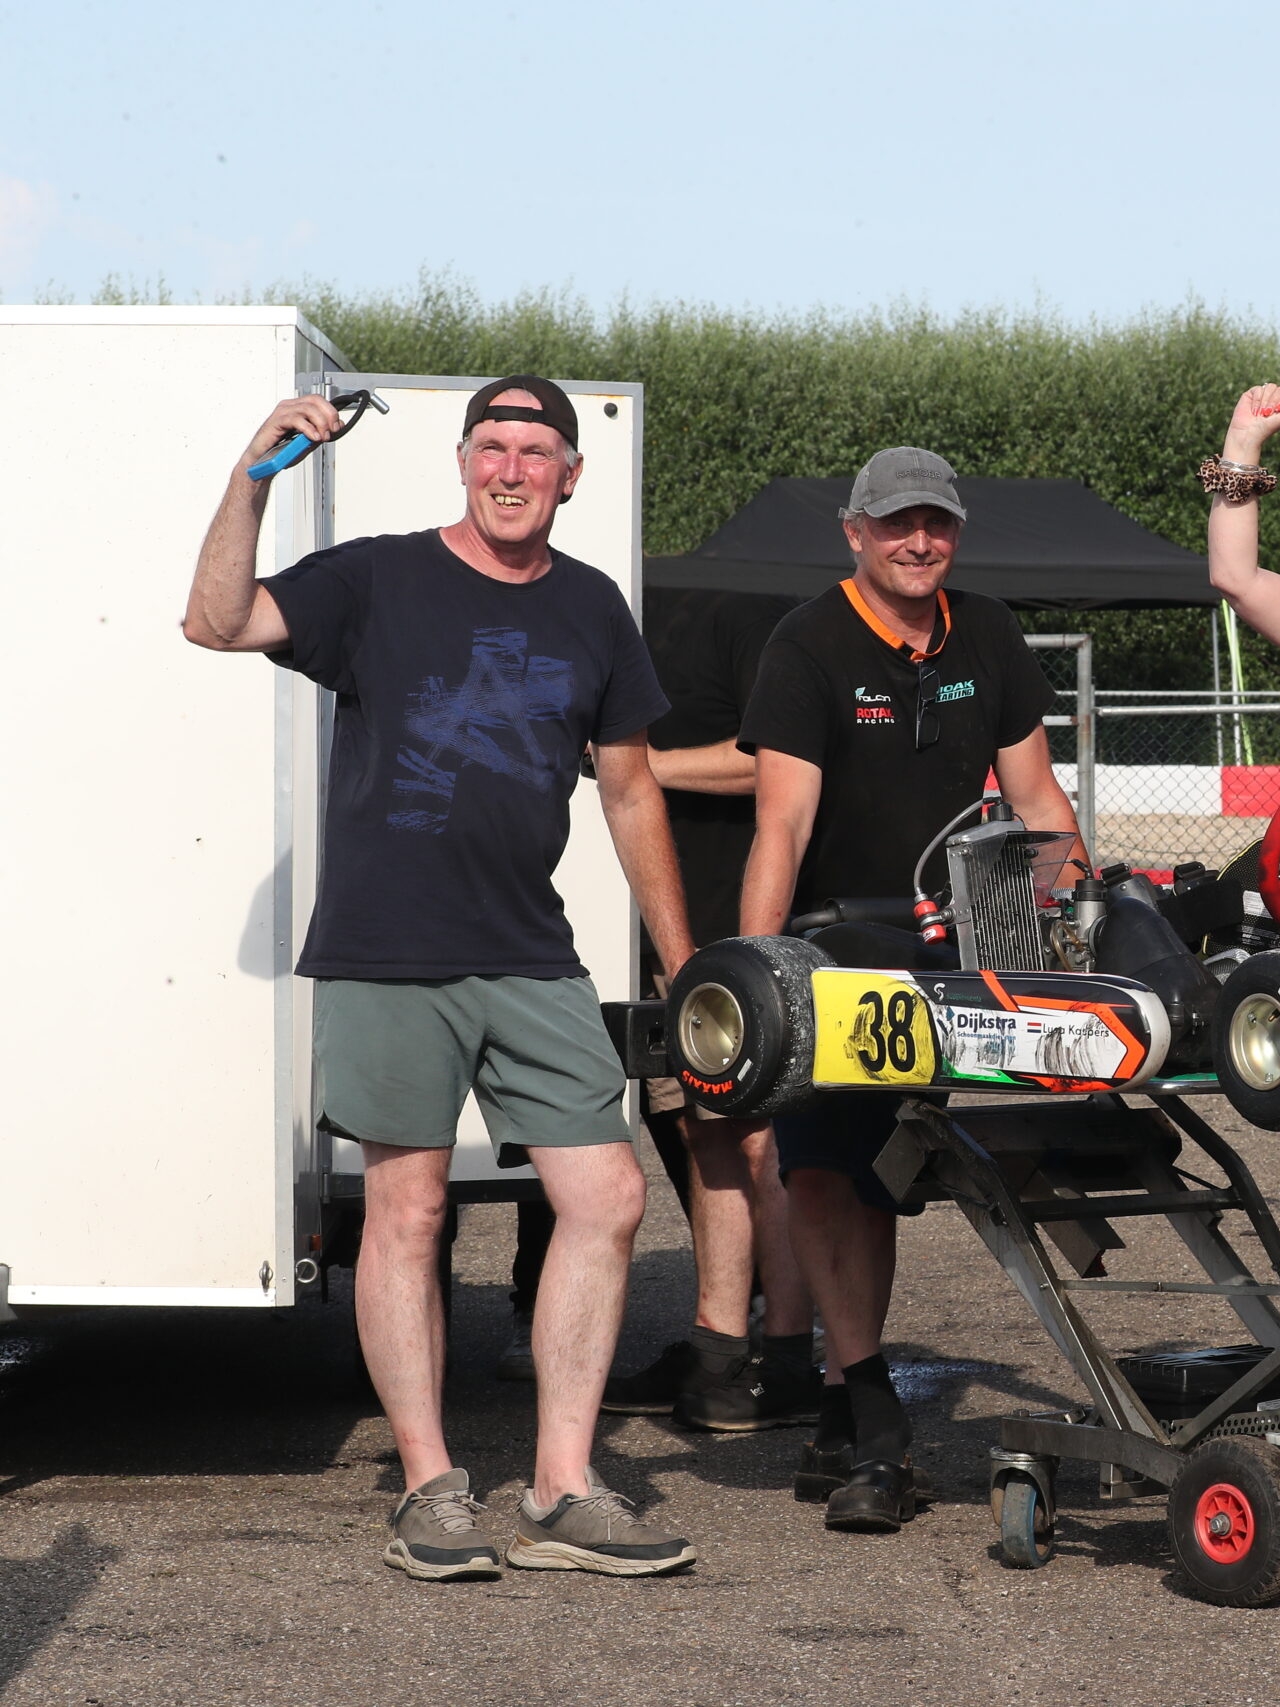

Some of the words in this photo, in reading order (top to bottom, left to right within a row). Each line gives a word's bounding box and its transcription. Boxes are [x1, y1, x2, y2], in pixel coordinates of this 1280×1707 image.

[858, 991, 916, 1072] 38
[957, 1013, 1016, 1033] Dijkstra
[1069, 1024, 1109, 1038] Kaspers
